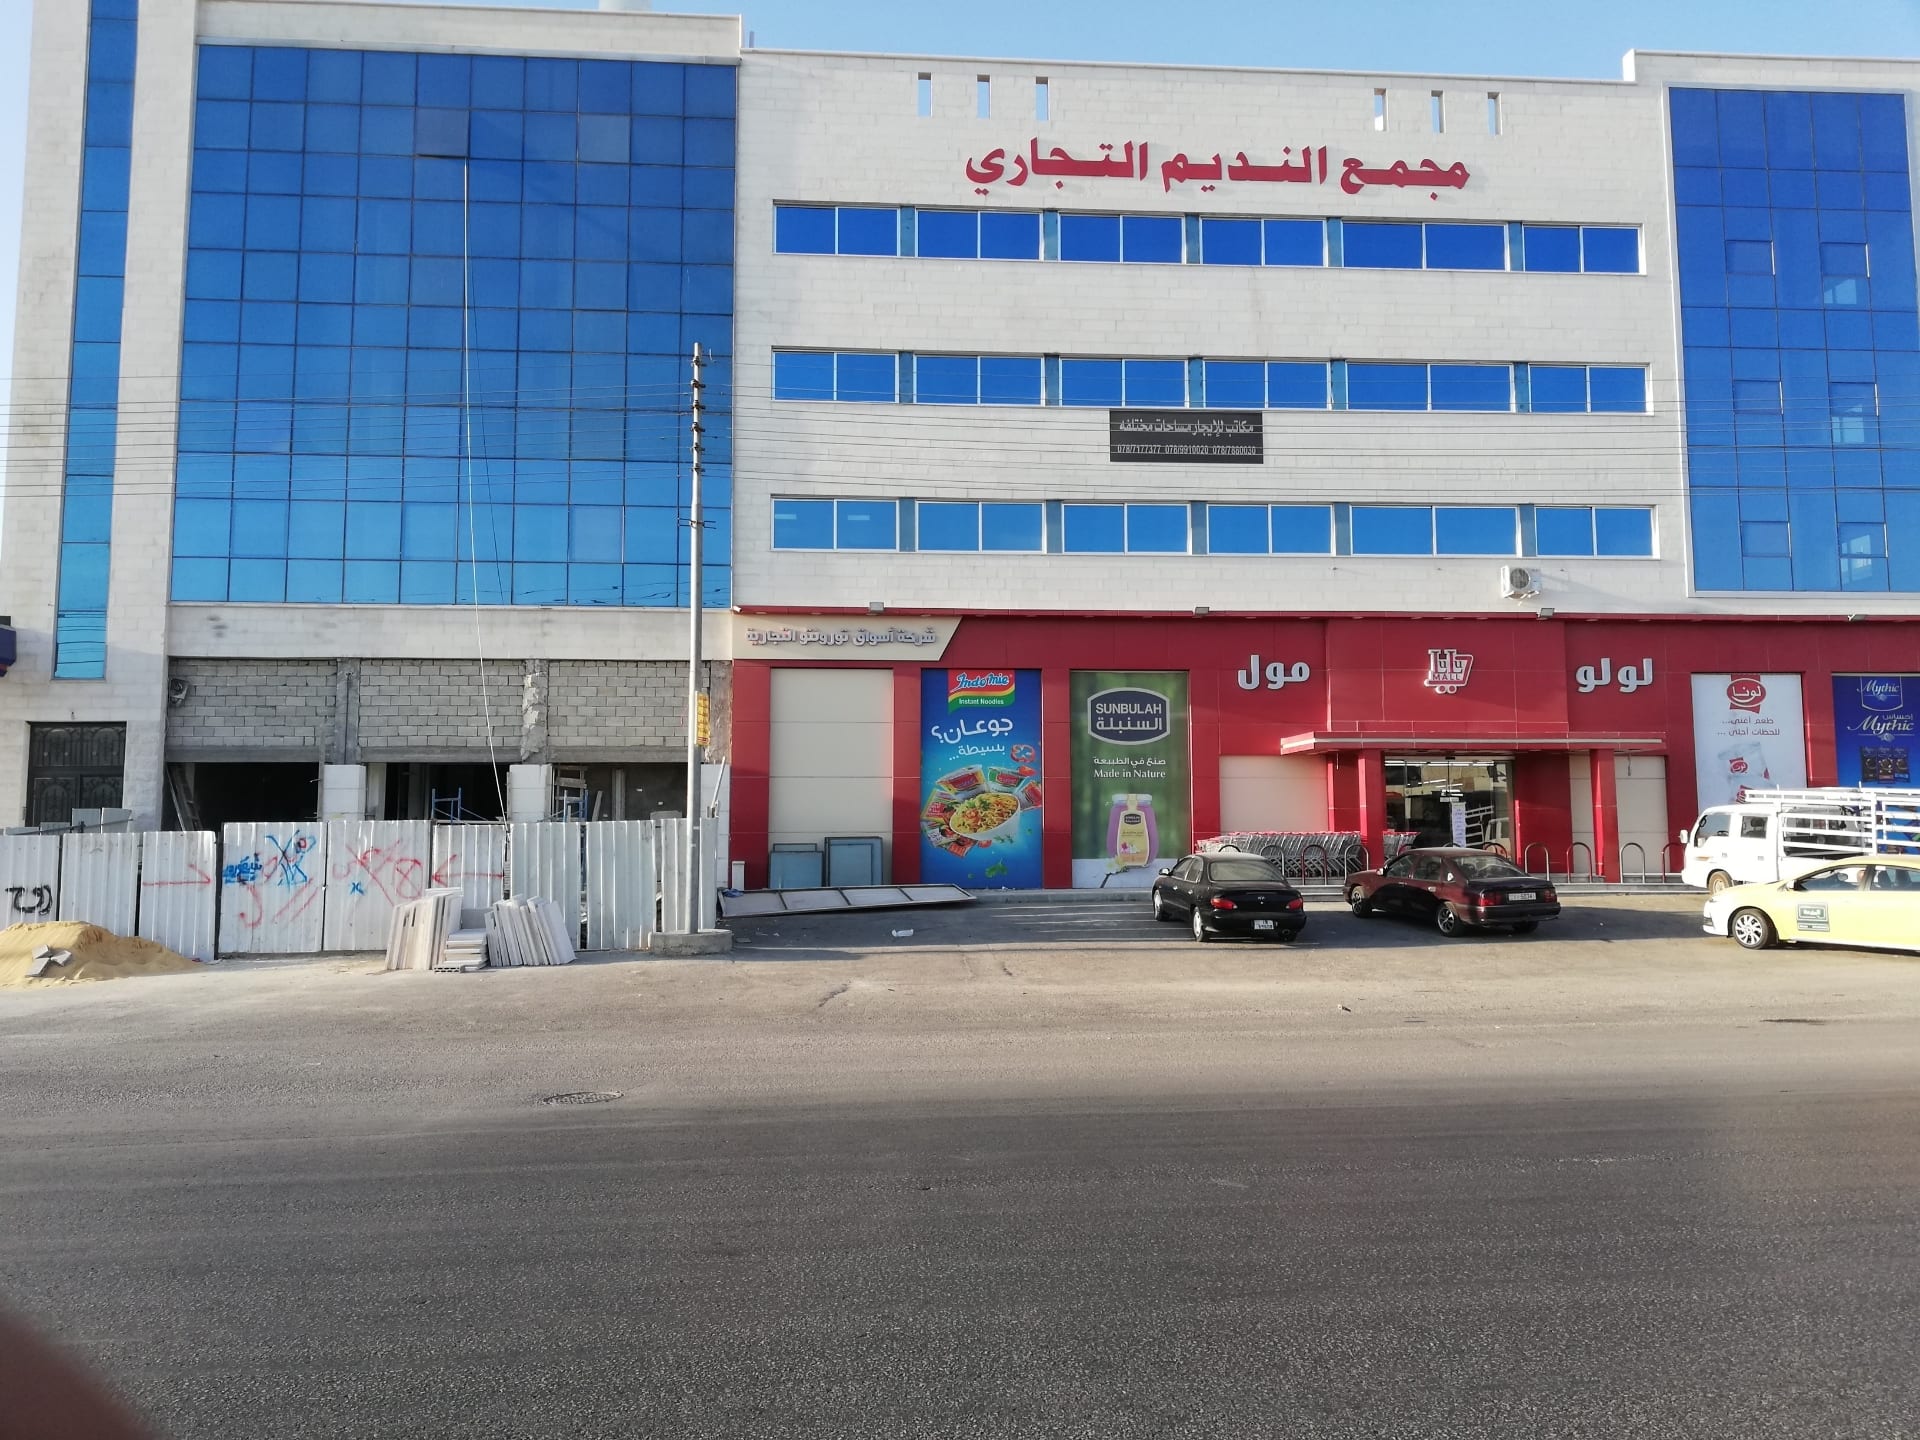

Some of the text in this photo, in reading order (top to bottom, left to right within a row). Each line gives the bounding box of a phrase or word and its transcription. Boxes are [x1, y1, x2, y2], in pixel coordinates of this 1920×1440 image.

[965, 137, 1471, 201] مجمع النديم التجاري
[1154, 418, 1191, 433] مساحات
[1225, 420, 1254, 437] مكاتب
[745, 627, 796, 646] التجارية
[1237, 654, 1654, 693] لولو مول
[1432, 673, 1461, 681] MALL
[1731, 685, 1762, 703] لونا
[1856, 679, 1900, 696] Mythic
[1095, 702, 1163, 715] SUNBULAH
[1096, 716, 1163, 734] السنبلة
[1846, 715, 1915, 735] Mythic
[1130, 757, 1145, 769] في
[1146, 757, 1167, 767] صنع
[1093, 768, 1167, 779] Made in Nature
